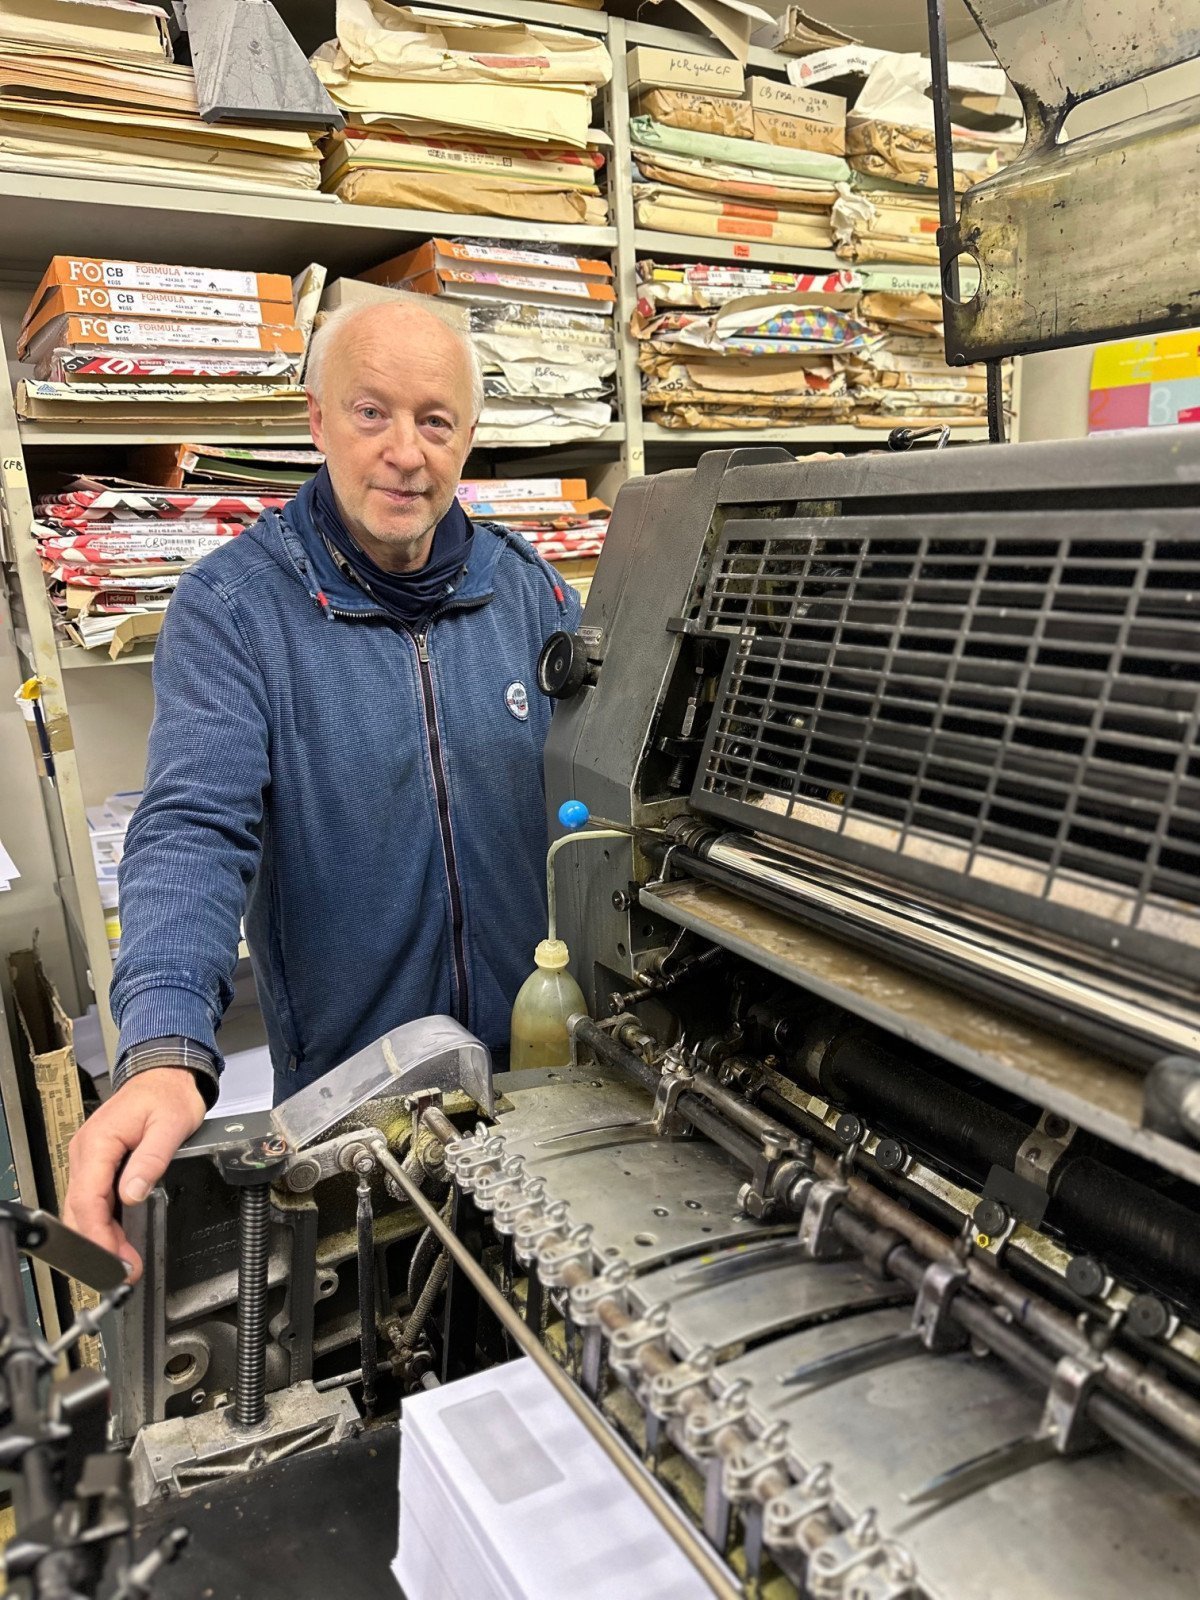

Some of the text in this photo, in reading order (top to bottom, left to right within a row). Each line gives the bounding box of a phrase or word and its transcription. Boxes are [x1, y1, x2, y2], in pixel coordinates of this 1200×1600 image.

[68, 261, 102, 282] FO
[106, 267, 124, 277] CB
[135, 265, 181, 276] FORMULA
[451, 270, 475, 281] FO
[75, 287, 110, 307] FO
[117, 293, 135, 304] CB
[141, 293, 186, 304] FORMULA
[79, 318, 109, 338] FO
[138, 323, 183, 333] FORMULA
[3, 460, 23, 471] CFB
[458, 487, 469, 496] CF
